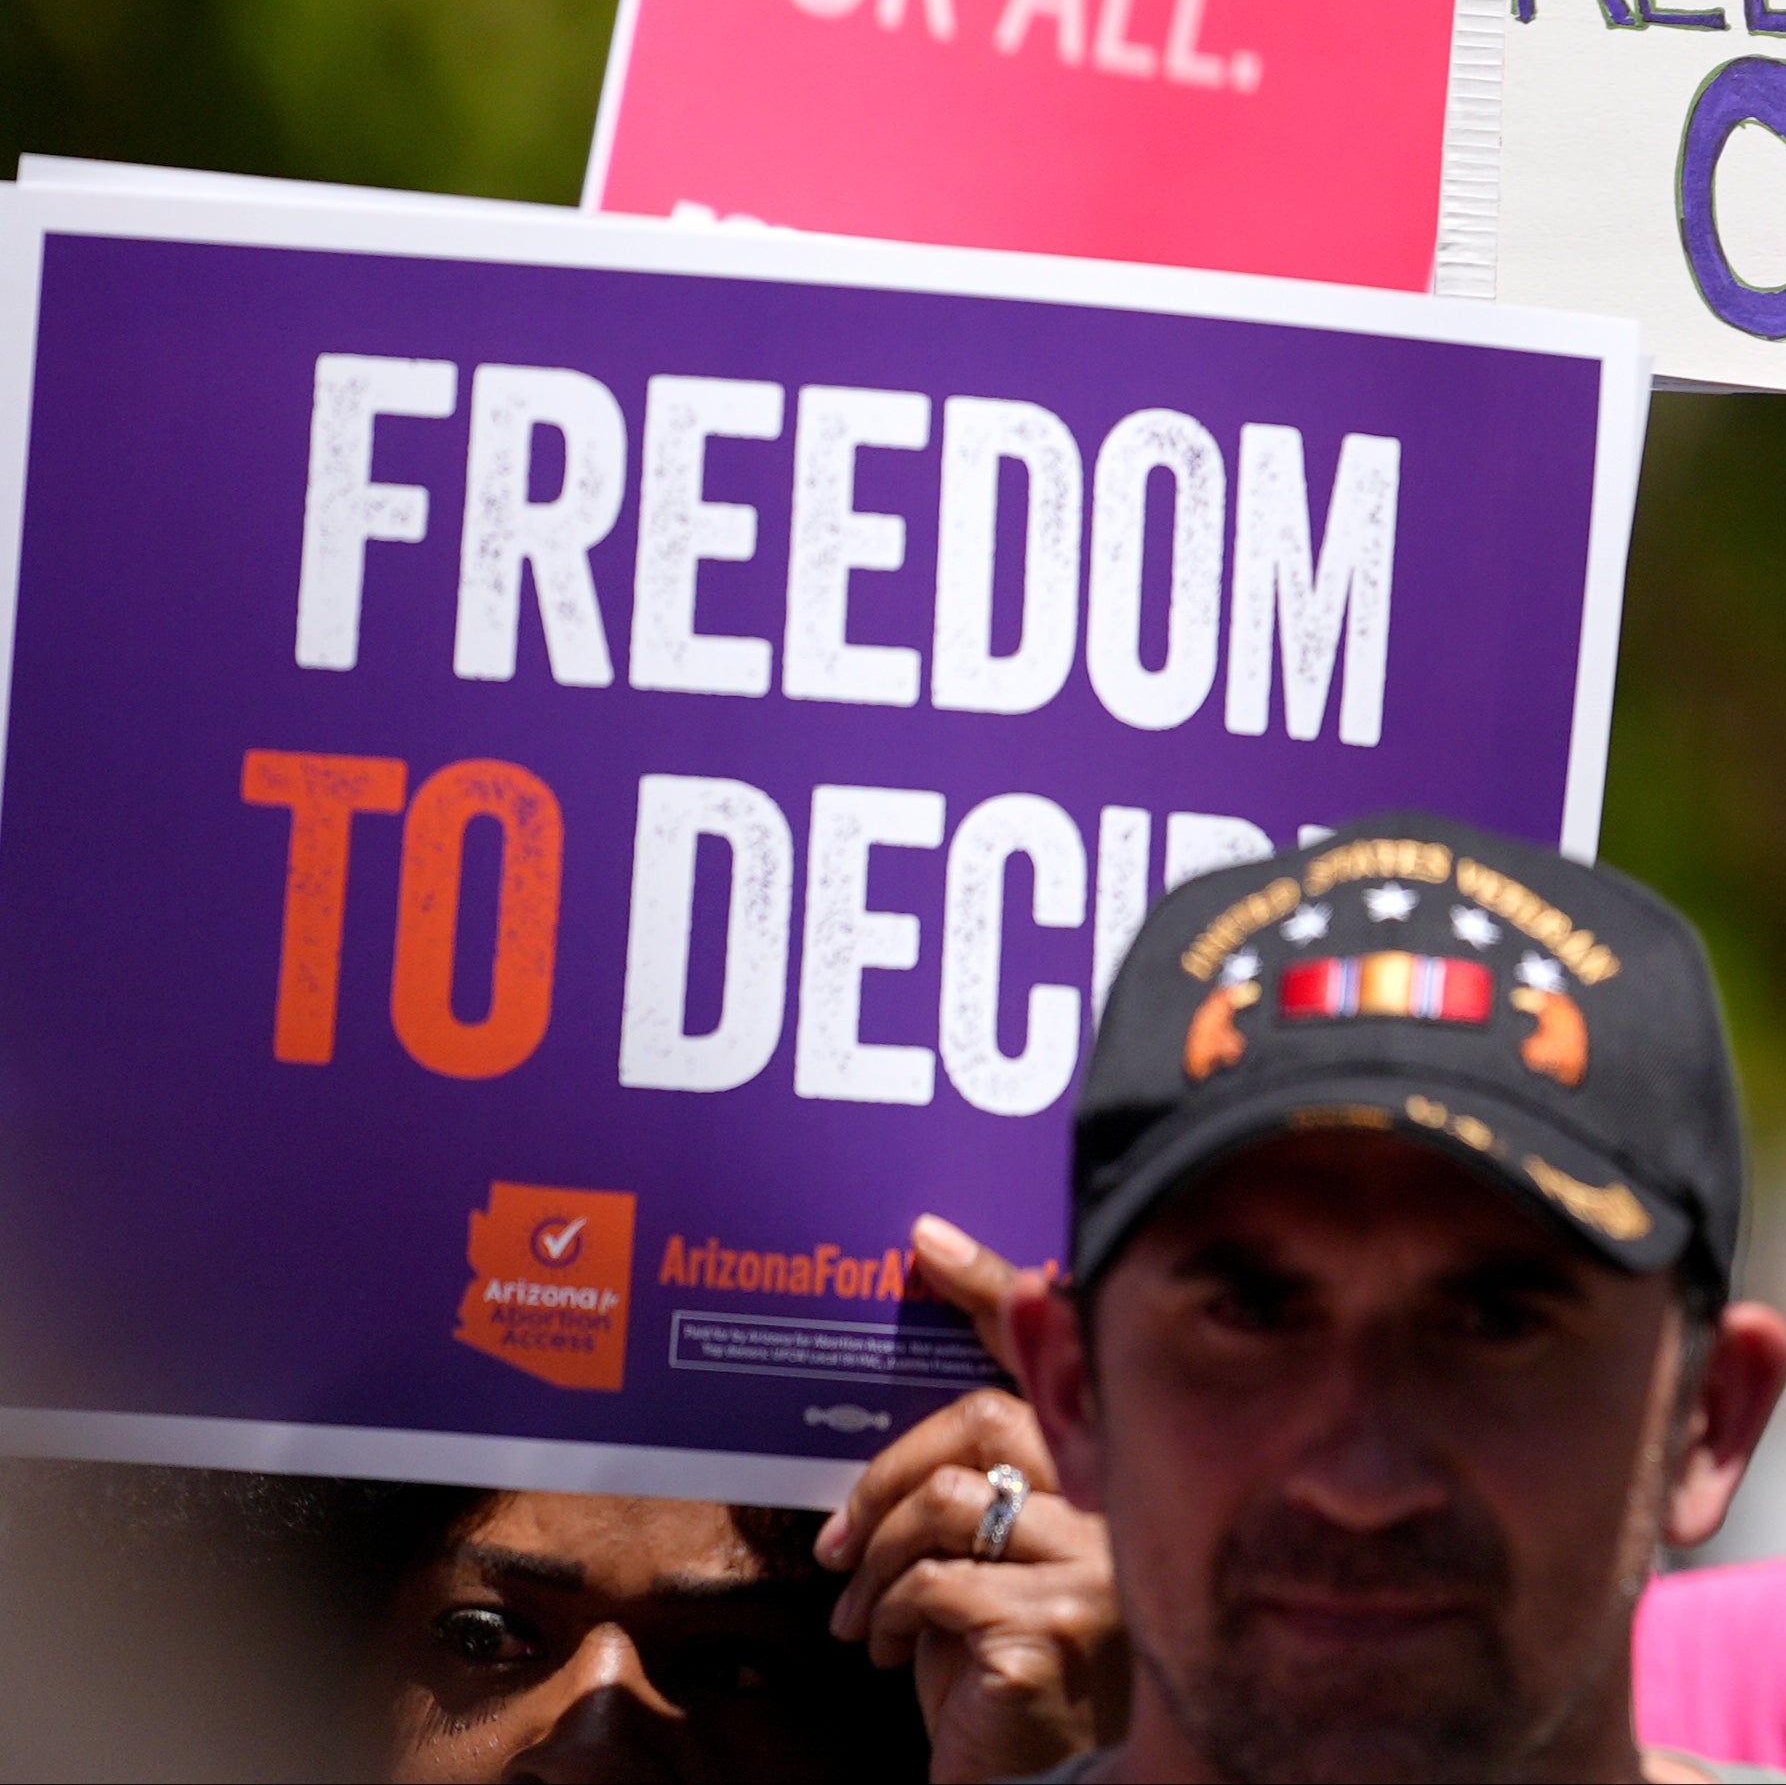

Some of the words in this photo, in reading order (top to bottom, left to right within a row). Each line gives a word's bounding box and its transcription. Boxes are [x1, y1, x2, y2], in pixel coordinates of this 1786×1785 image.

[292, 351, 1402, 747] FREEDOM
[240, 749, 565, 1080] TO
[483, 1277, 598, 1309] Arizona
